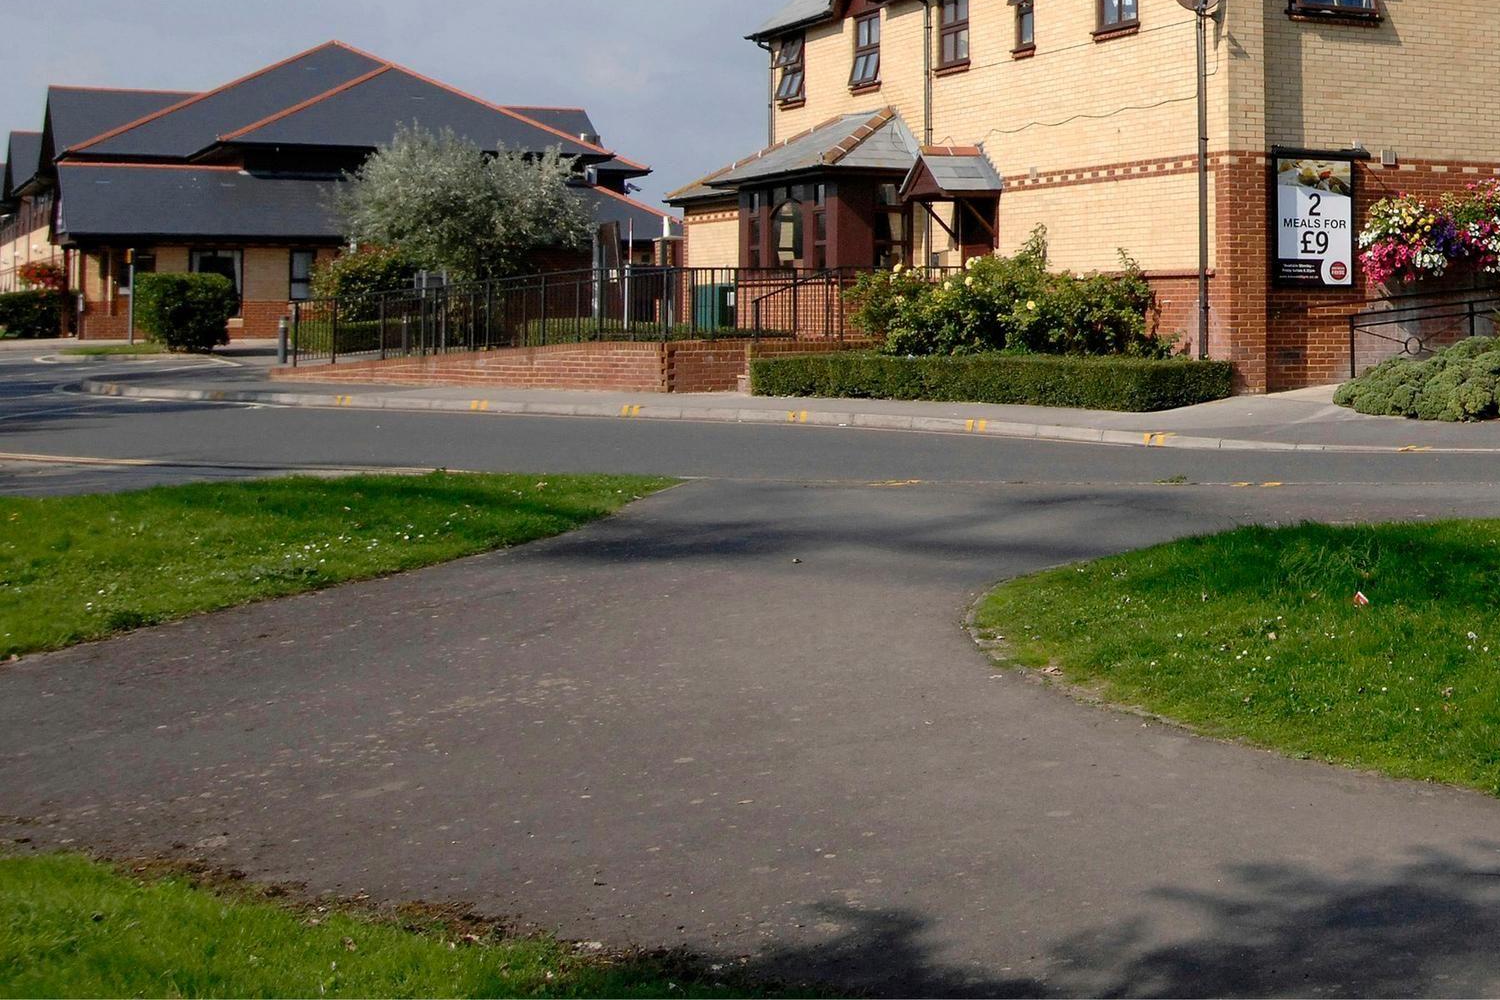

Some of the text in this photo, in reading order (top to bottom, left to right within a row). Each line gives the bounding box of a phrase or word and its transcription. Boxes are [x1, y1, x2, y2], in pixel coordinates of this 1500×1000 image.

[1309, 193, 1321, 216] 2
[1283, 218, 1347, 229] MEALS FOR
[1300, 231, 1329, 254] £9
